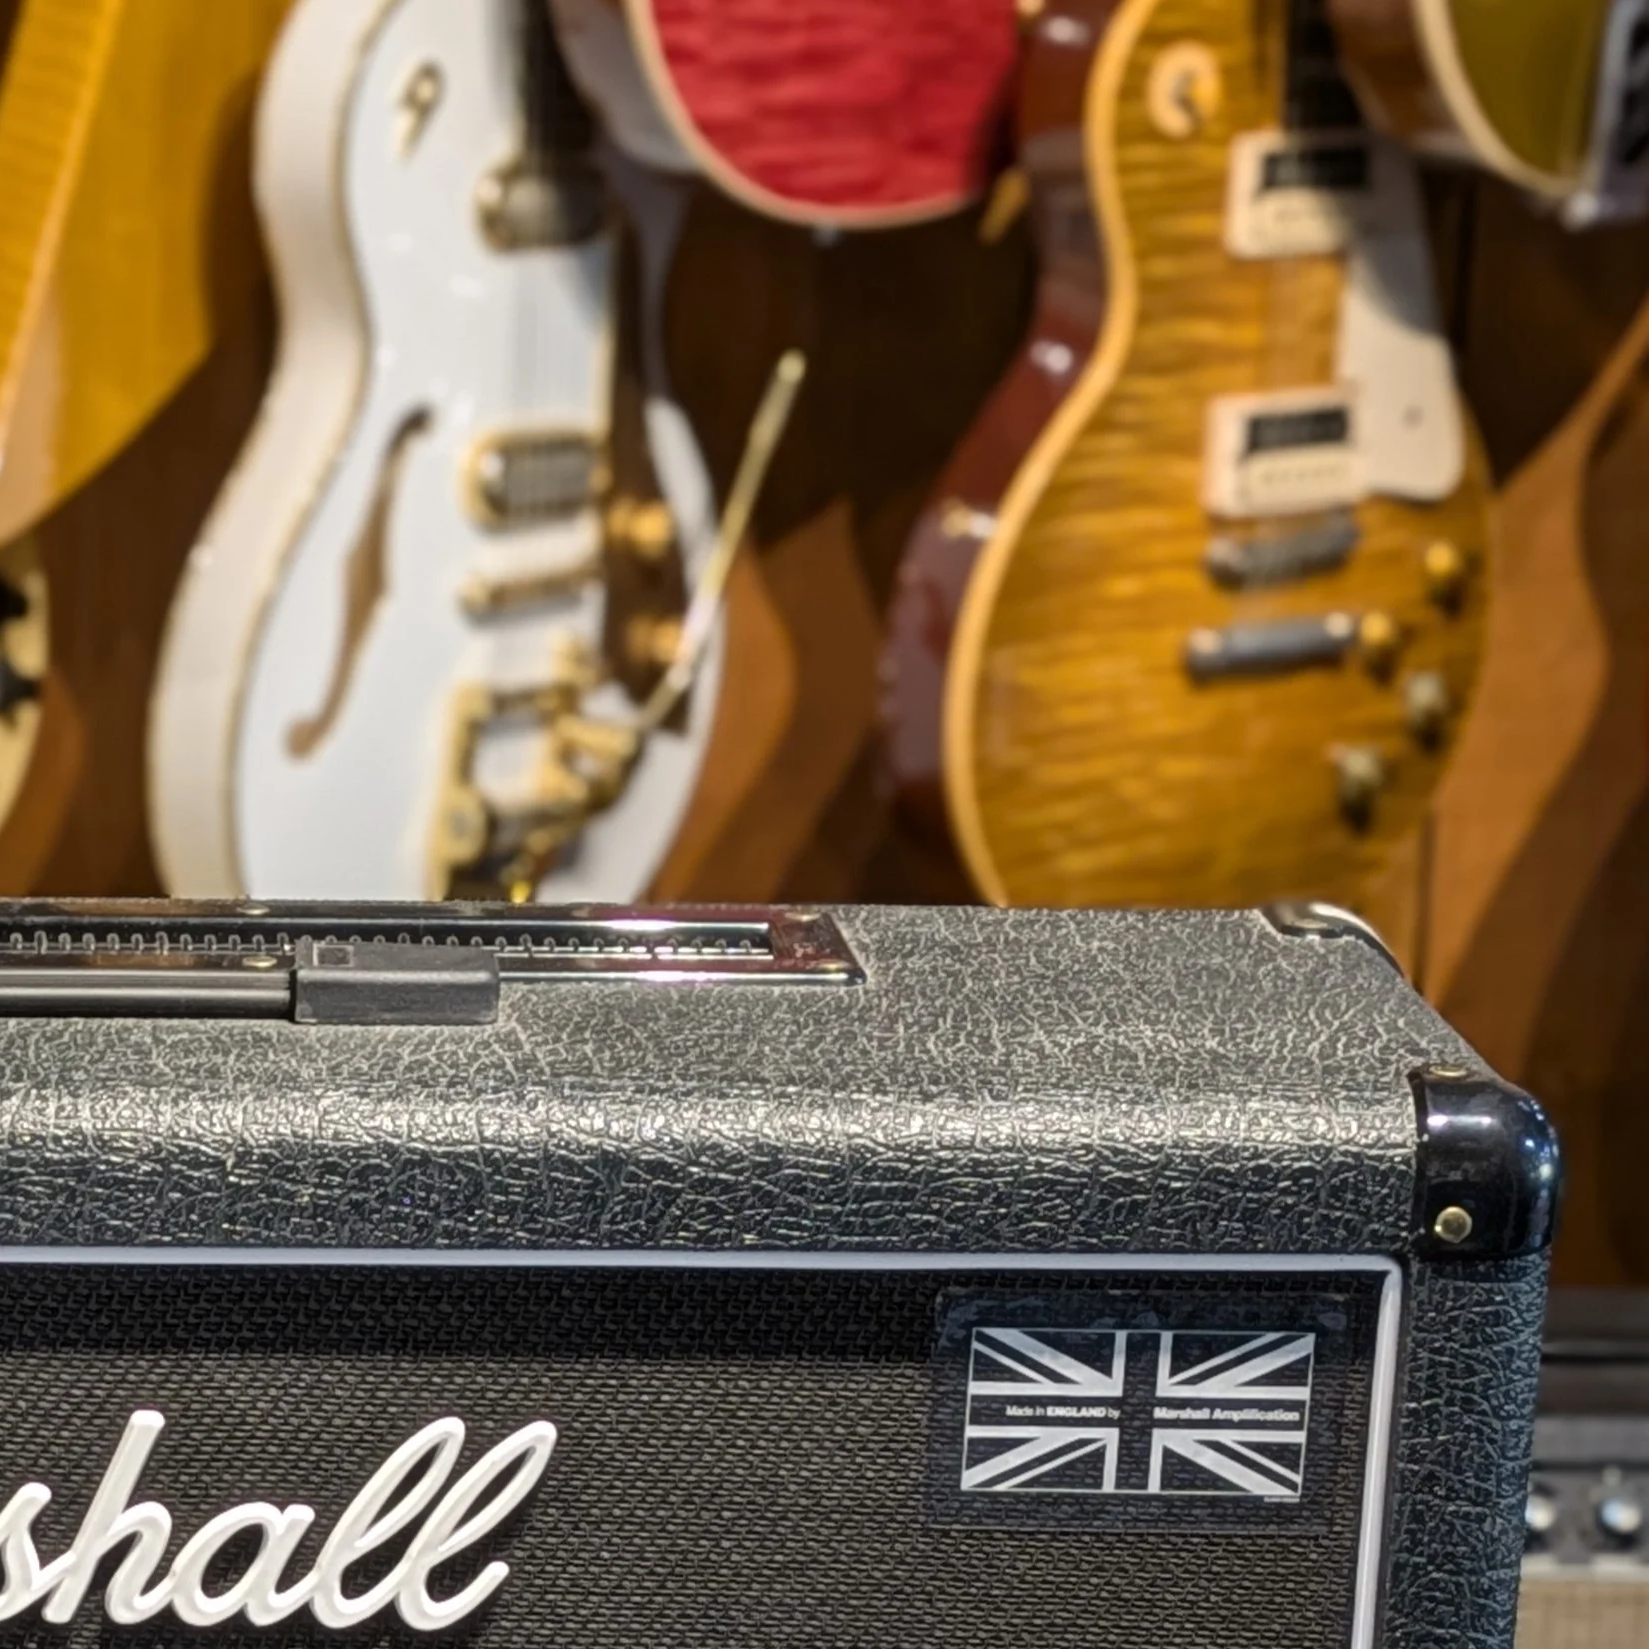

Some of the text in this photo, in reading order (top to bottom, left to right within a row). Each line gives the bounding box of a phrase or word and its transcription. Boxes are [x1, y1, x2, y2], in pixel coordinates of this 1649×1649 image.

[1005, 1405, 1033, 1417] Made
[1046, 1406, 1106, 1418] ENGLAND
[1108, 1407, 1121, 1420] by
[1154, 1408, 1211, 1420] Marshall
[1212, 1408, 1300, 1422] Amplification
